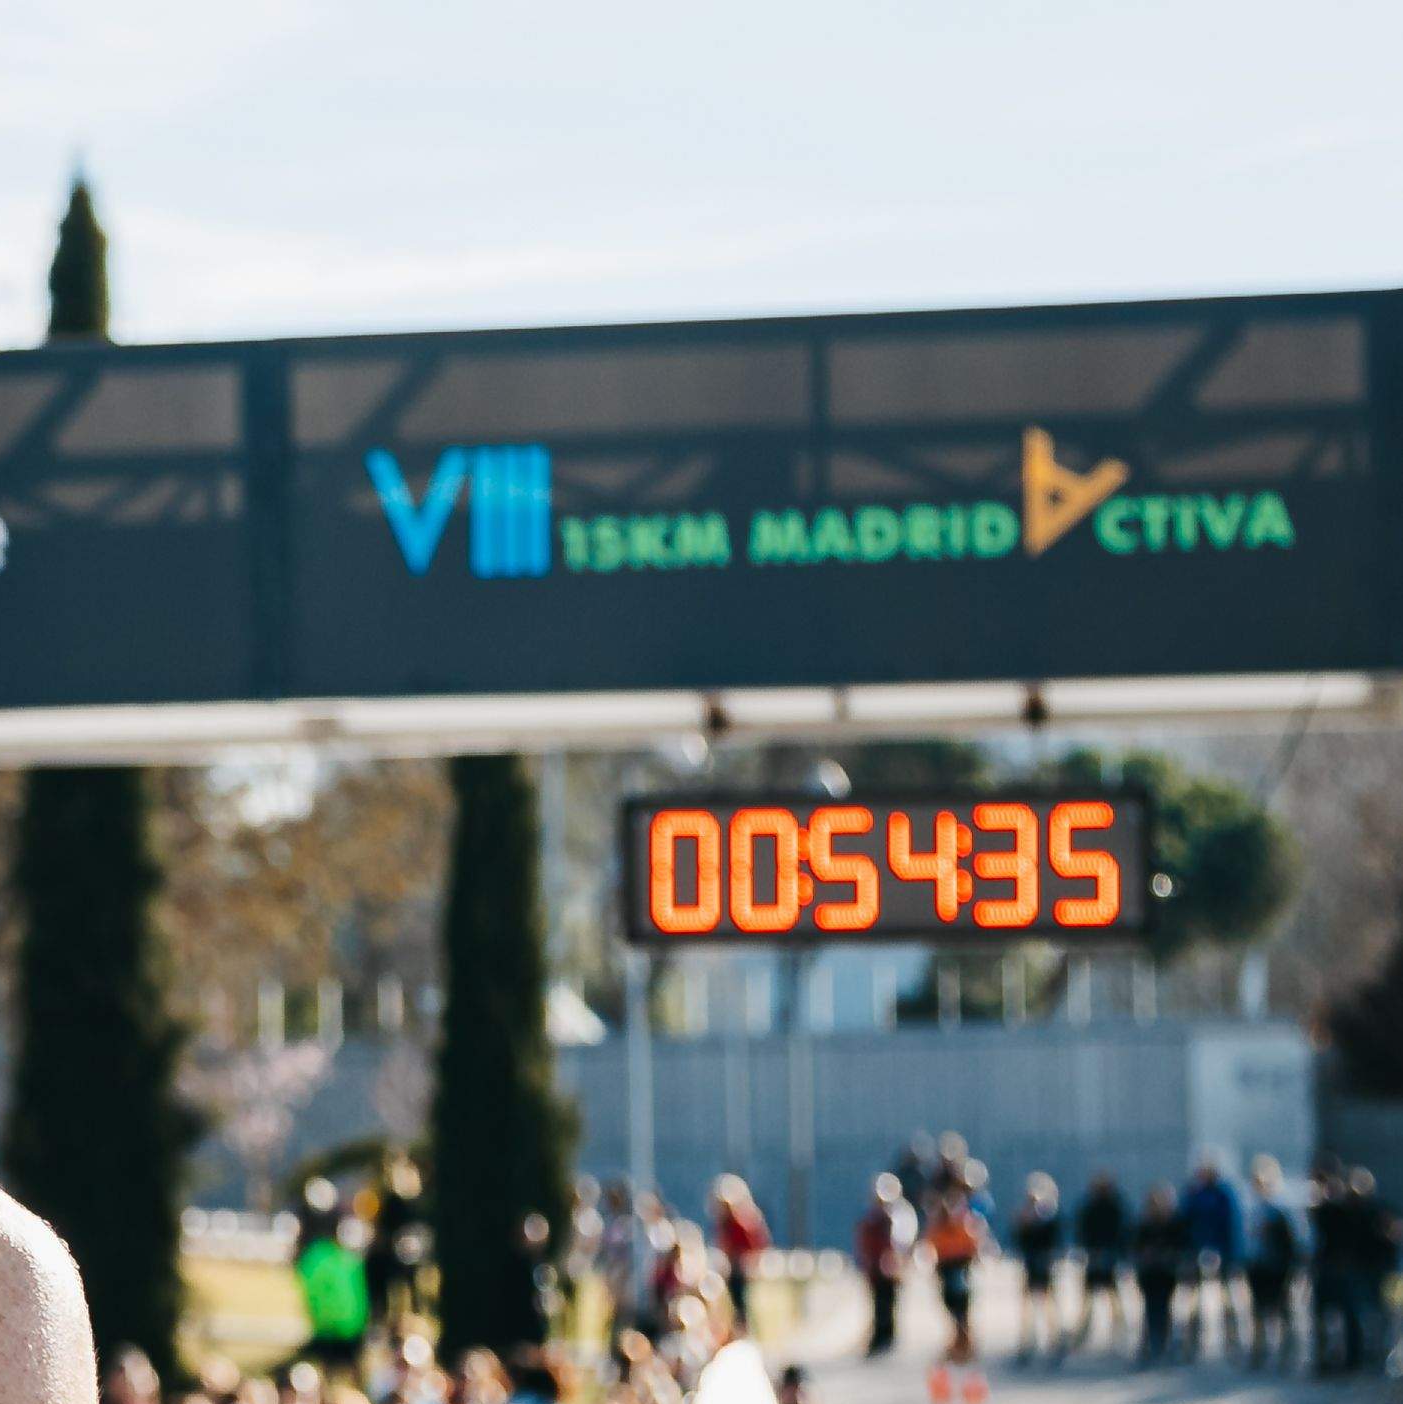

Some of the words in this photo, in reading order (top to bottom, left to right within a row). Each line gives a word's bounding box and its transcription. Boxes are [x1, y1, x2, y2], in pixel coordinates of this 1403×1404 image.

[365, 444, 553, 579] VIII
[559, 508, 730, 574] 15KM
[749, 501, 1019, 566] MADRID
